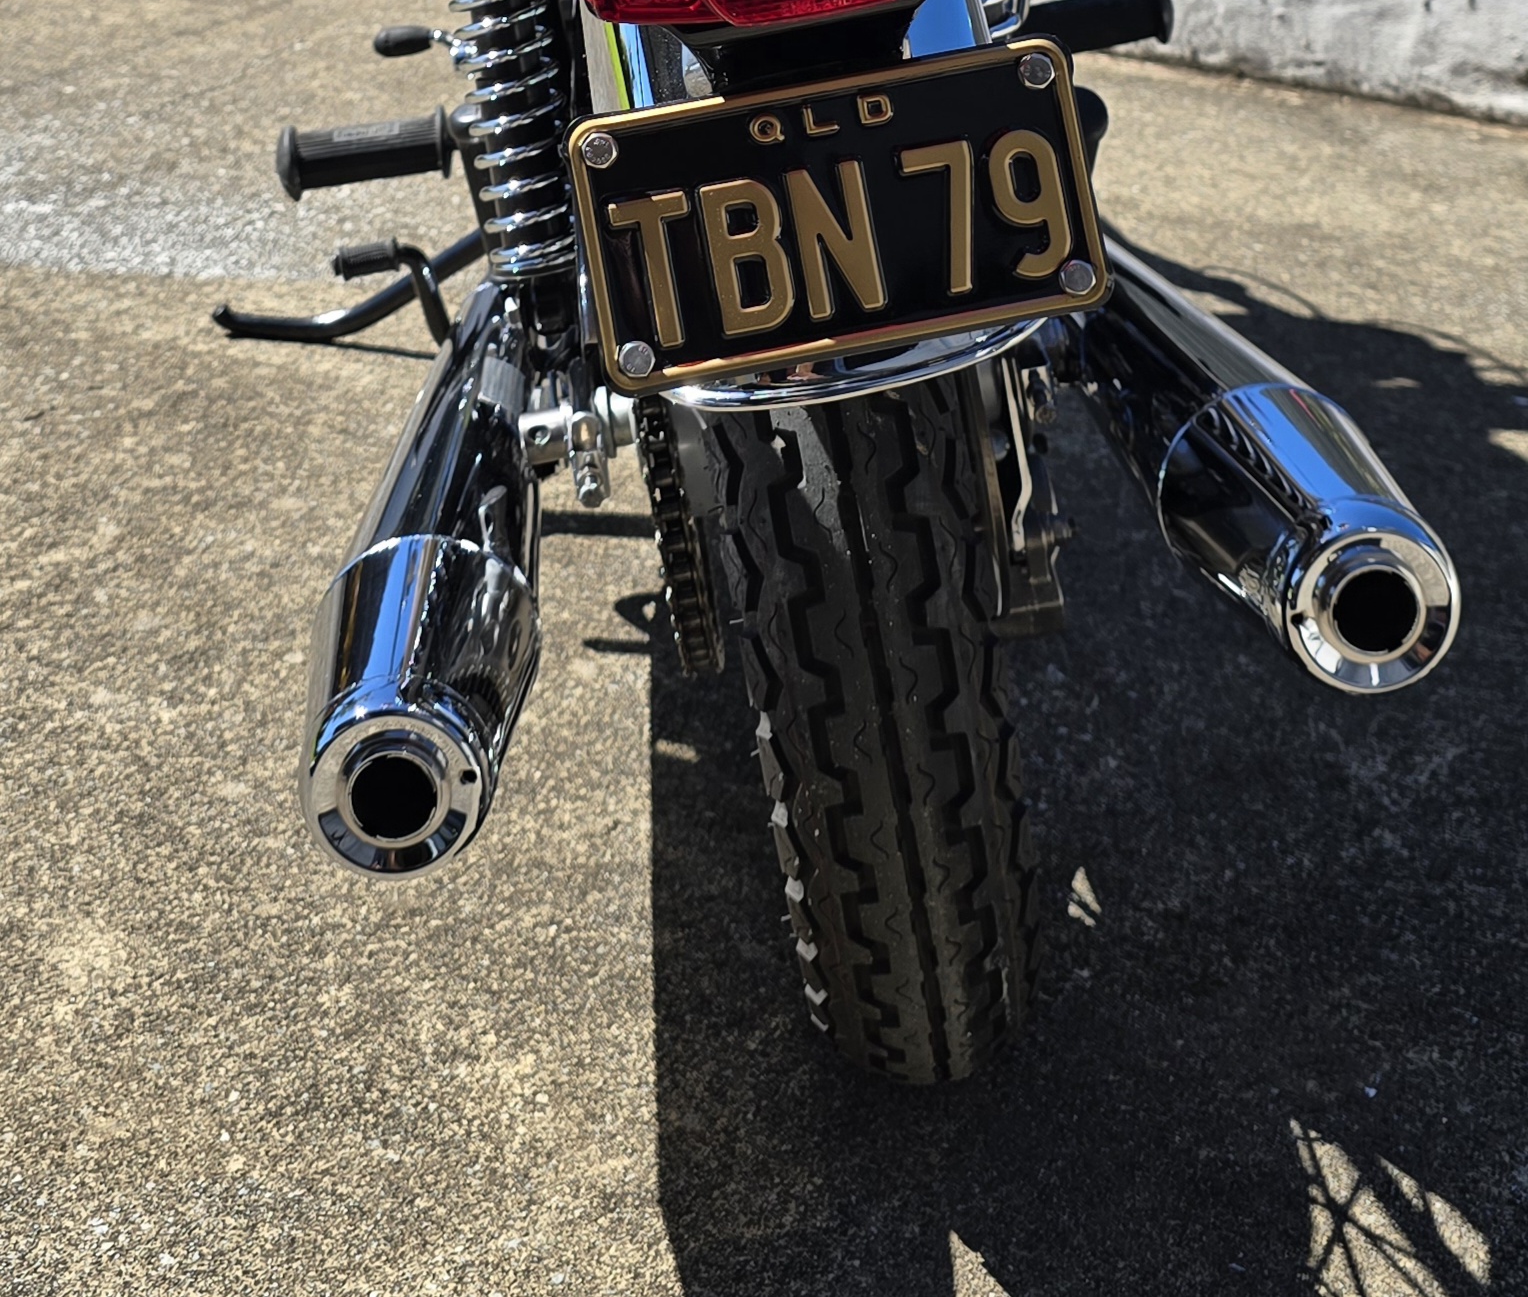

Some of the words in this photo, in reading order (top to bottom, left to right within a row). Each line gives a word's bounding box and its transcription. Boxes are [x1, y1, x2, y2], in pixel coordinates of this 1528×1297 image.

[749, 93, 894, 144] QLD
[608, 160, 888, 348] TBN
[900, 129, 1072, 295] 79
